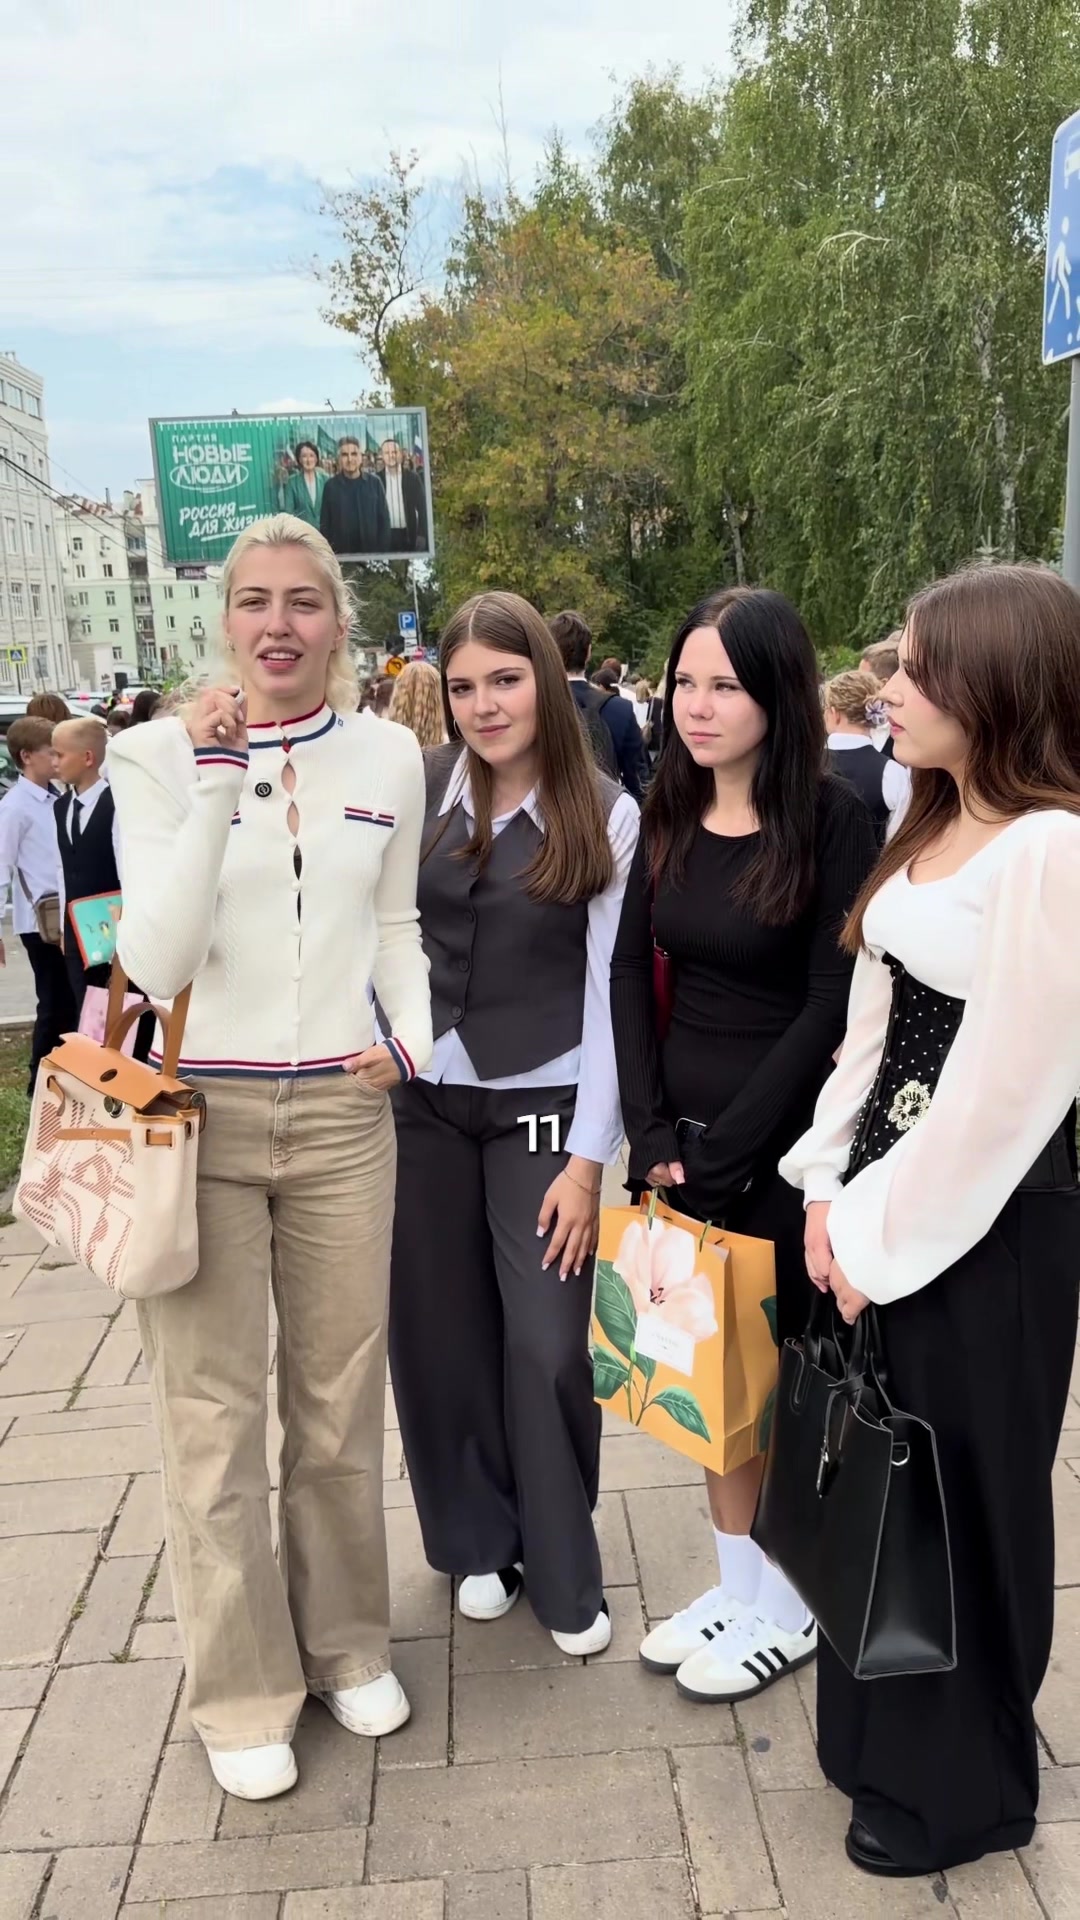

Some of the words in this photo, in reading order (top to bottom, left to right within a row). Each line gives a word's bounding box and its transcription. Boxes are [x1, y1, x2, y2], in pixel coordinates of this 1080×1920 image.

[172, 433, 217, 443] ПАРТИЯ
[173, 443, 253, 464] НОВЫЕ
[176, 464, 242, 485] ЛЮДИ
[179, 502, 236, 526] РОССИЯ
[188, 519, 219, 538] ДЛЯ
[402, 614, 412, 629] P
